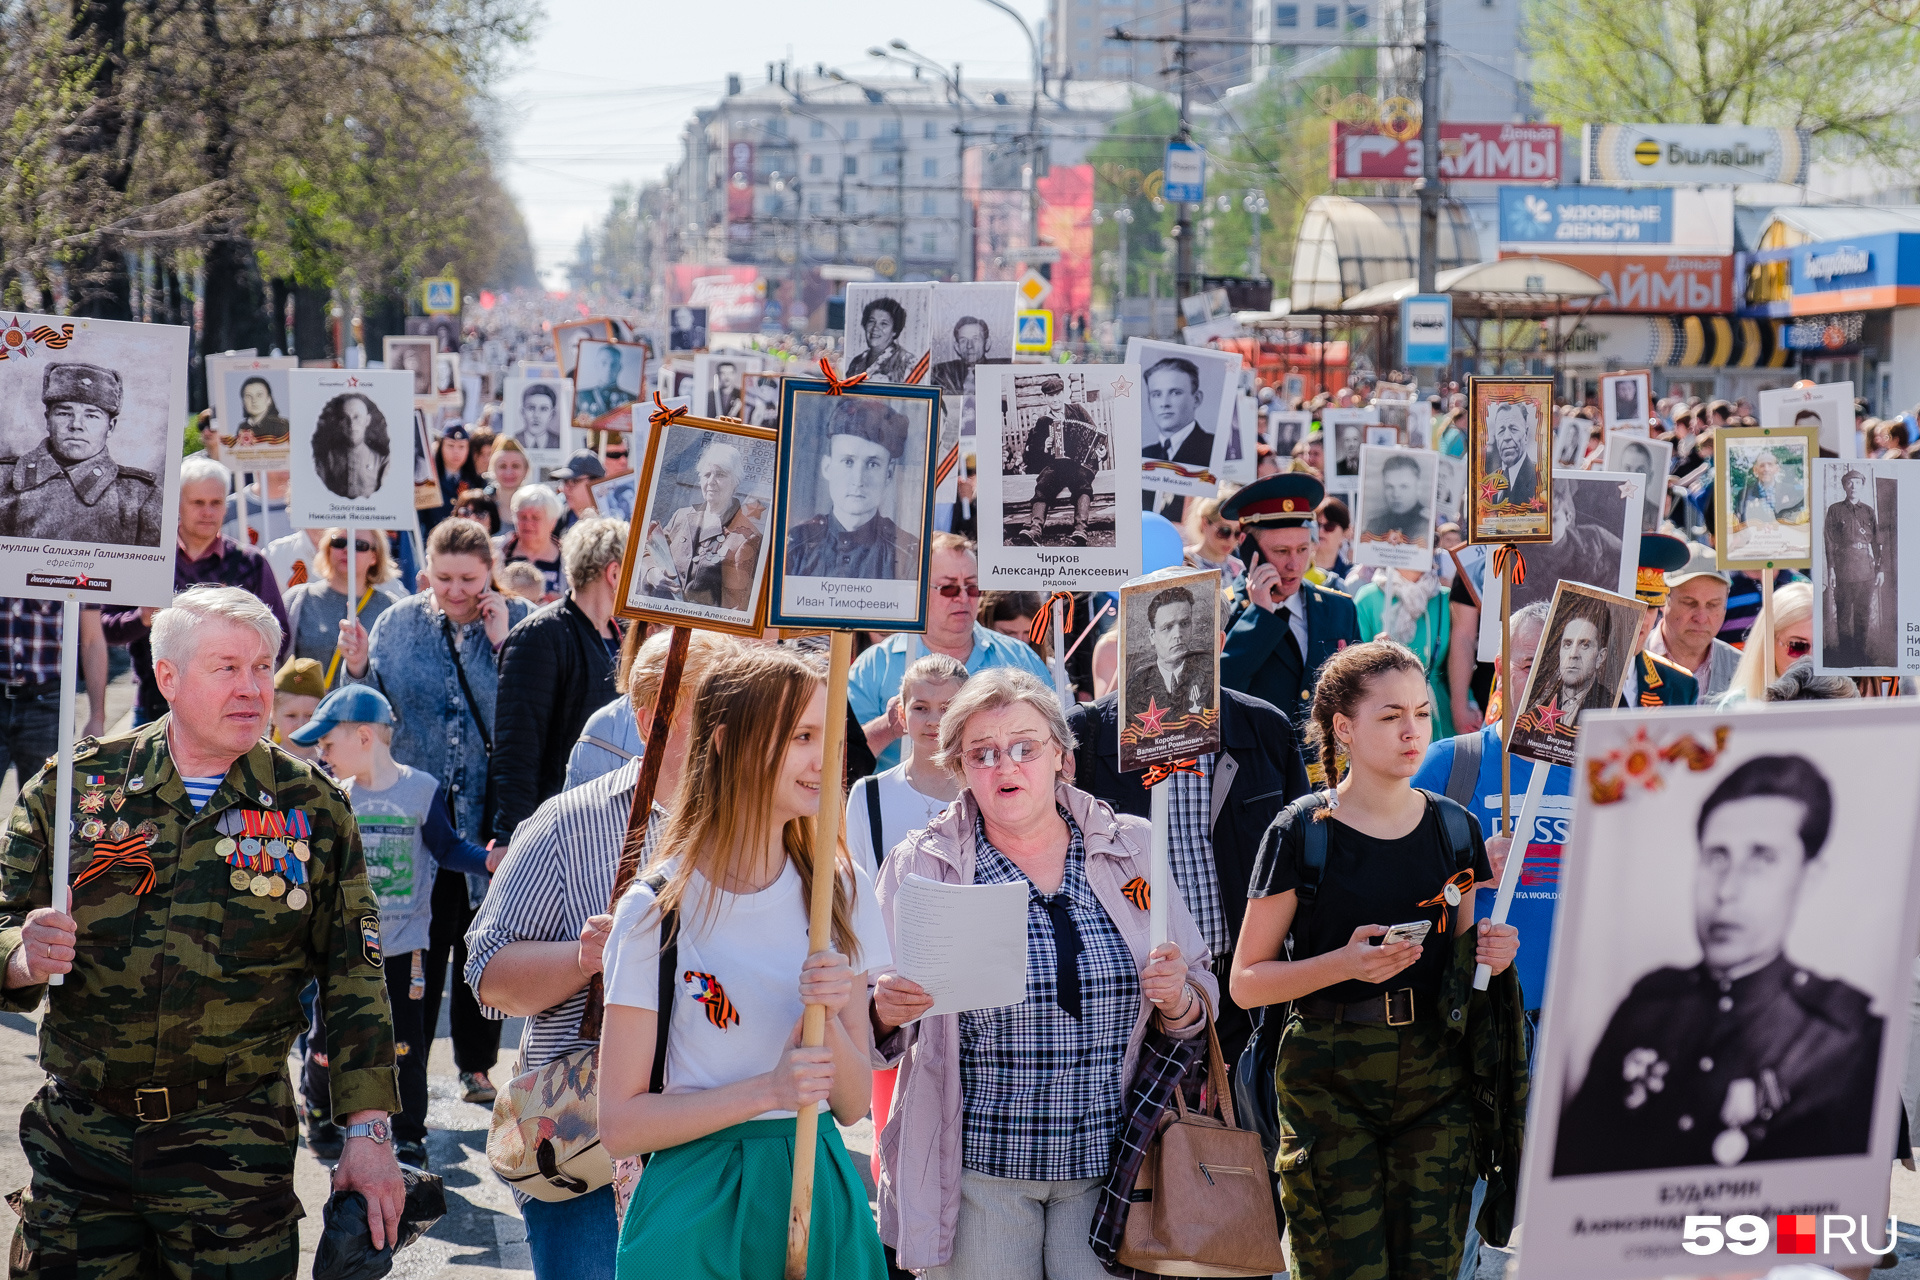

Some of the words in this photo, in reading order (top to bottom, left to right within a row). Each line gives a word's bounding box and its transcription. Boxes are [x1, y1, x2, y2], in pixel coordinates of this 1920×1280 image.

[1556, 203, 1662, 223] УДОБНЫЕ
[1554, 222, 1641, 240] ДЕНЬГИ
[1568, 264, 1722, 308] АЙМЫ
[42, 545, 91, 557] Салихзян
[93, 549, 166, 562] Галимзянович
[1036, 553, 1080, 565] Чирков
[46, 559, 94, 569] ефрейтор
[991, 565, 1056, 577] Александр
[1058, 567, 1129, 577] Алексеевич
[821, 581, 873, 594] Крупенко
[1042, 579, 1077, 587] рядовой
[796, 596, 825, 607] Иван
[828, 596, 899, 610] Тимофеевич
[628, 598, 662, 611] Черныш
[664, 604, 702, 617] Антонина
[704, 610, 751, 624] Алексеевна
[1136, 745, 1167, 756] Валентин
[1168, 737, 1204, 749] Романович
[1527, 739, 1552, 750] Николай
[1529, 891, 1557, 900] WORLD
